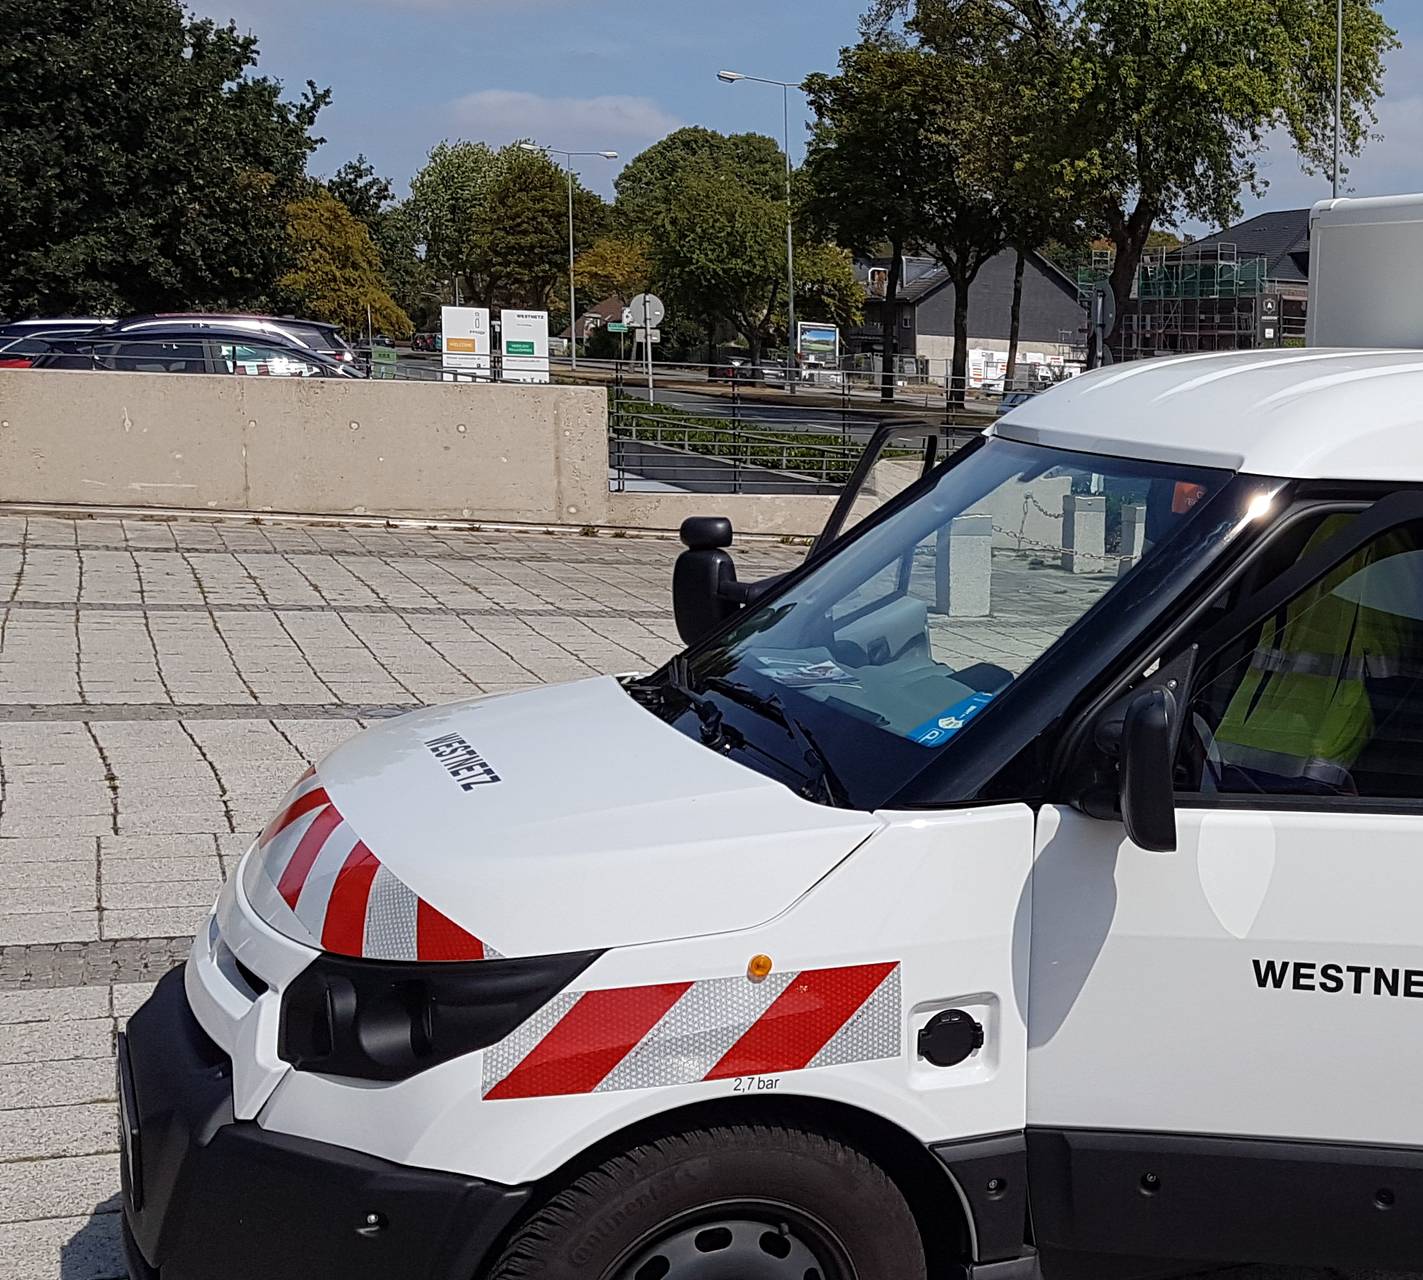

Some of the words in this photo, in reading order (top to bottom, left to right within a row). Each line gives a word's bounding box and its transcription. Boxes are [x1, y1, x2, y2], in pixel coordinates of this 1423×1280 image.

[424, 732, 502, 791] WESTNETZ
[733, 1077, 755, 1093] 2,7
[757, 1076, 780, 1090] bar
